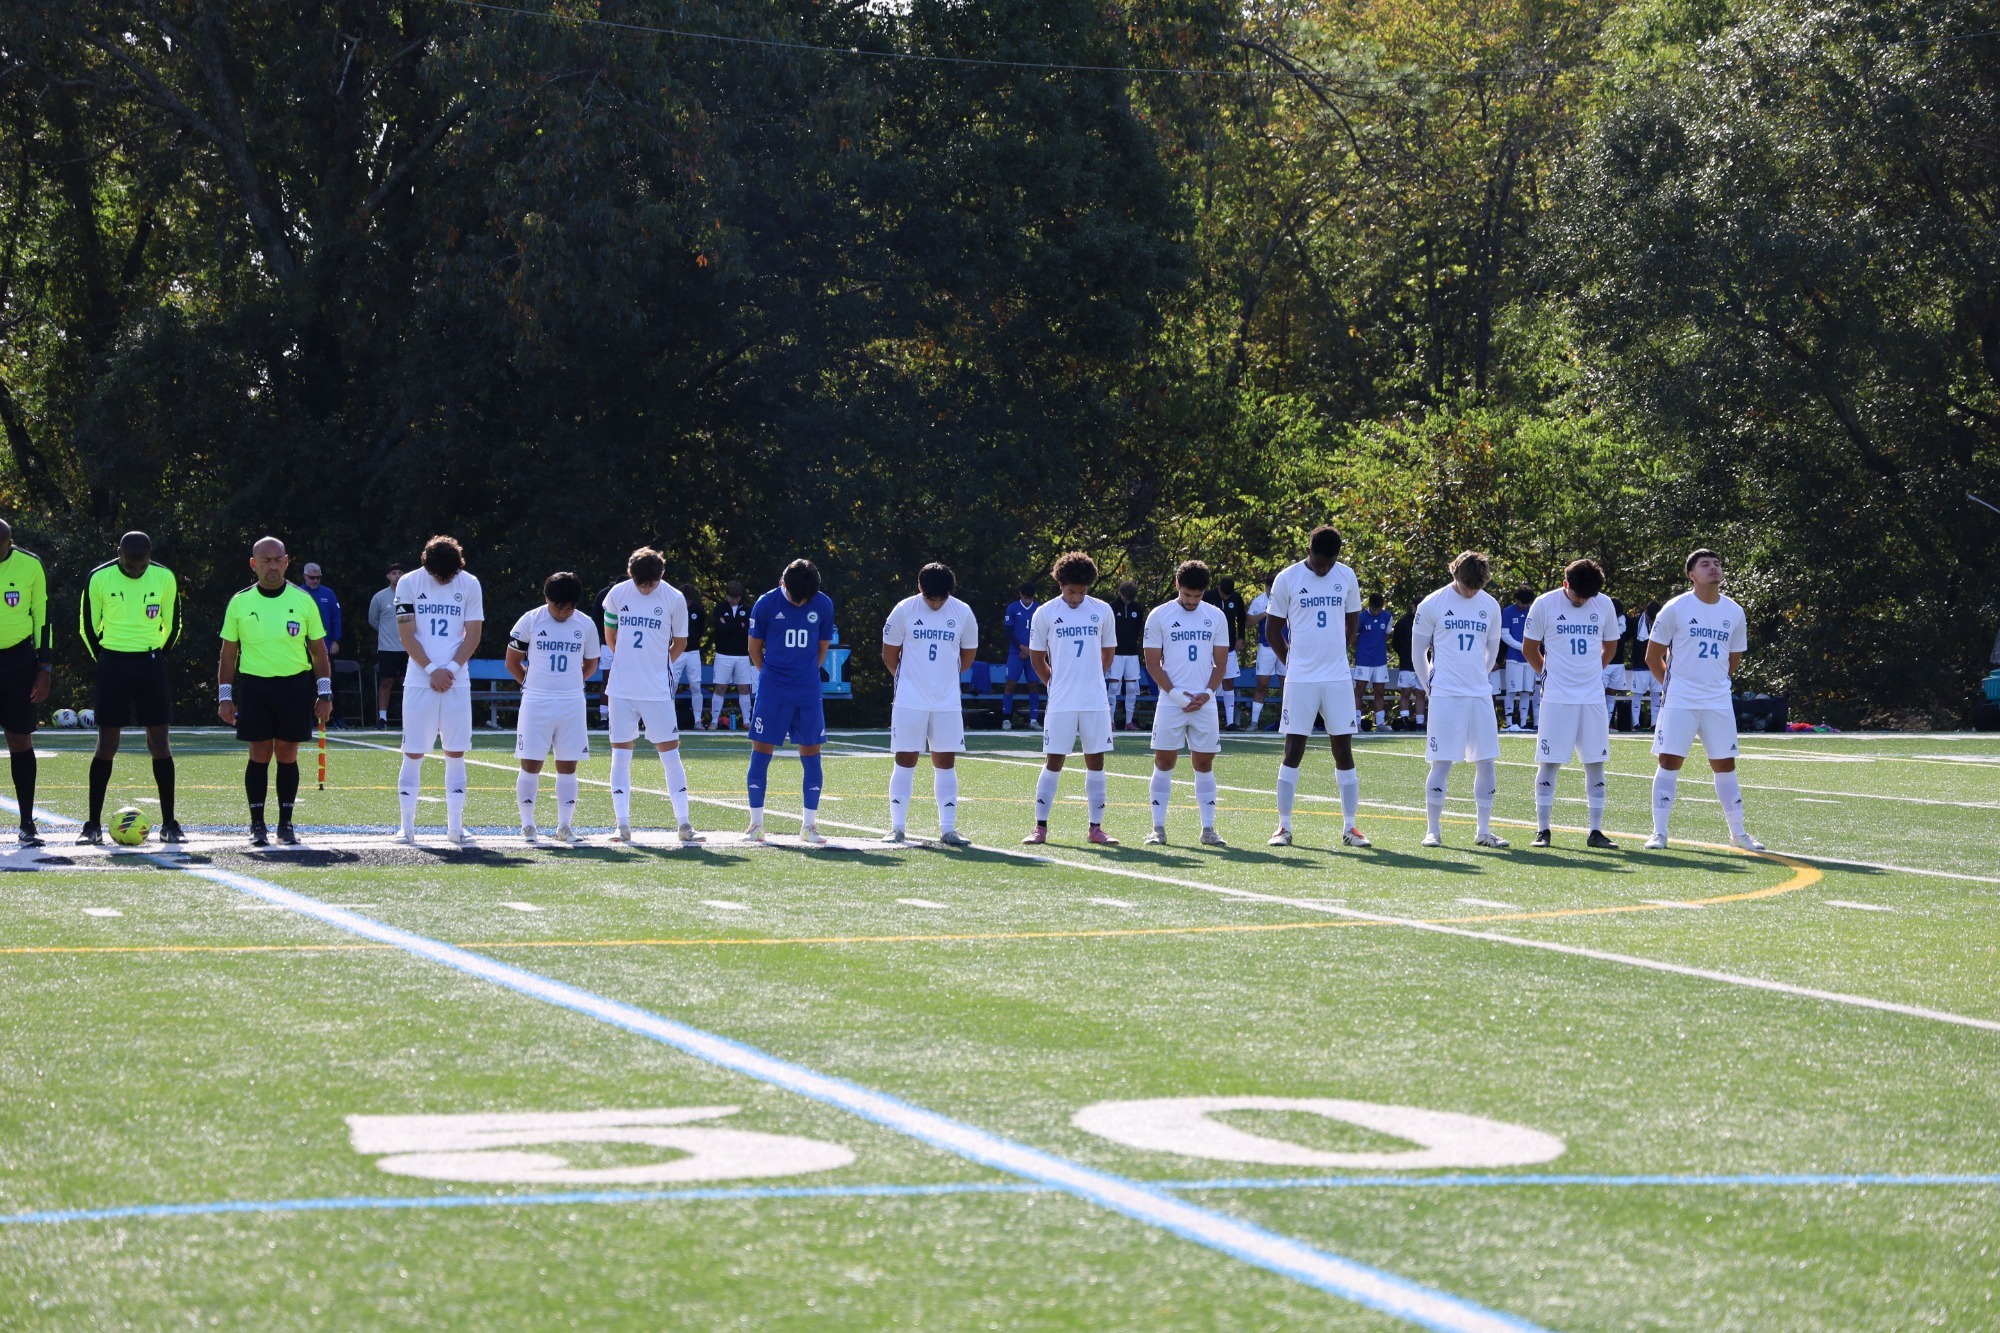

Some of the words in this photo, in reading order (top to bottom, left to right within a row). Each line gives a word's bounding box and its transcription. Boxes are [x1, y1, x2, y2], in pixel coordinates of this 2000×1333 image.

[417, 603, 461, 617] SHORTER
[1300, 596, 1342, 608] SHORTER
[430, 618, 449, 636] 12
[620, 616, 662, 629] SHORTER
[1317, 610, 1327, 628] 9
[1445, 619, 1487, 633] SHORTER
[913, 629, 955, 642] SHORTER
[1056, 626, 1098, 638] SHORTER
[1170, 630, 1212, 641] SHORTER
[1556, 624, 1599, 635] SHORTER
[1690, 627, 1729, 641] SHORTER
[536, 640, 582, 653] SHORTER
[633, 631, 643, 649] 2
[785, 629, 808, 648] 00
[1457, 634, 1475, 651] 17
[1570, 638, 1587, 655] 18
[928, 643, 938, 662] 6
[1073, 639, 1084, 657] 7
[1188, 644, 1198, 662] 8
[1698, 642, 1719, 659] 24
[550, 654, 568, 673] 10
[1541, 739, 1550, 755] SU
